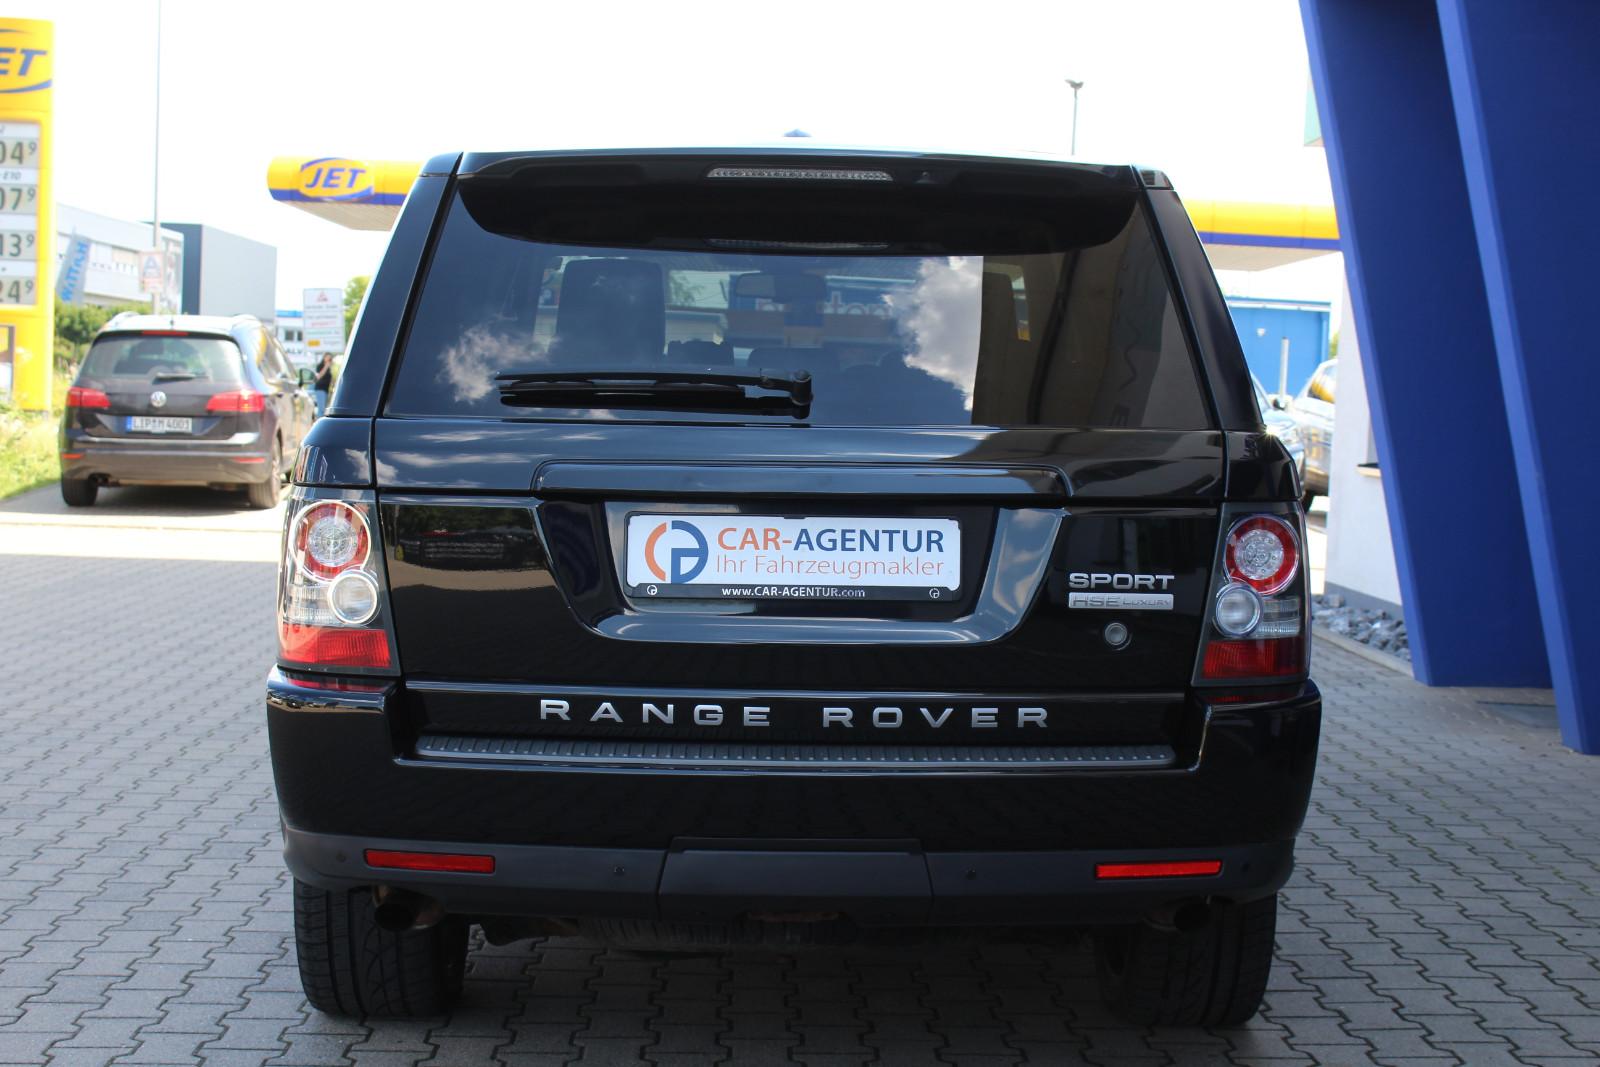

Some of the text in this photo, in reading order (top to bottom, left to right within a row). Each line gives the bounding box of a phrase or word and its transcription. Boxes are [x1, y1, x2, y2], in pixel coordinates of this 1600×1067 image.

[305, 168, 366, 188] JET
[717, 527, 945, 553] CAR-AGENTUR
[716, 555, 945, 580] Ihr Fahrzeugmakler
[1068, 573, 1174, 590] SPORT
[721, 586, 866, 598] www.CAR-AGENTUR.com
[1073, 595, 1120, 607] HSE
[540, 699, 1049, 728] RANGE ROVER
